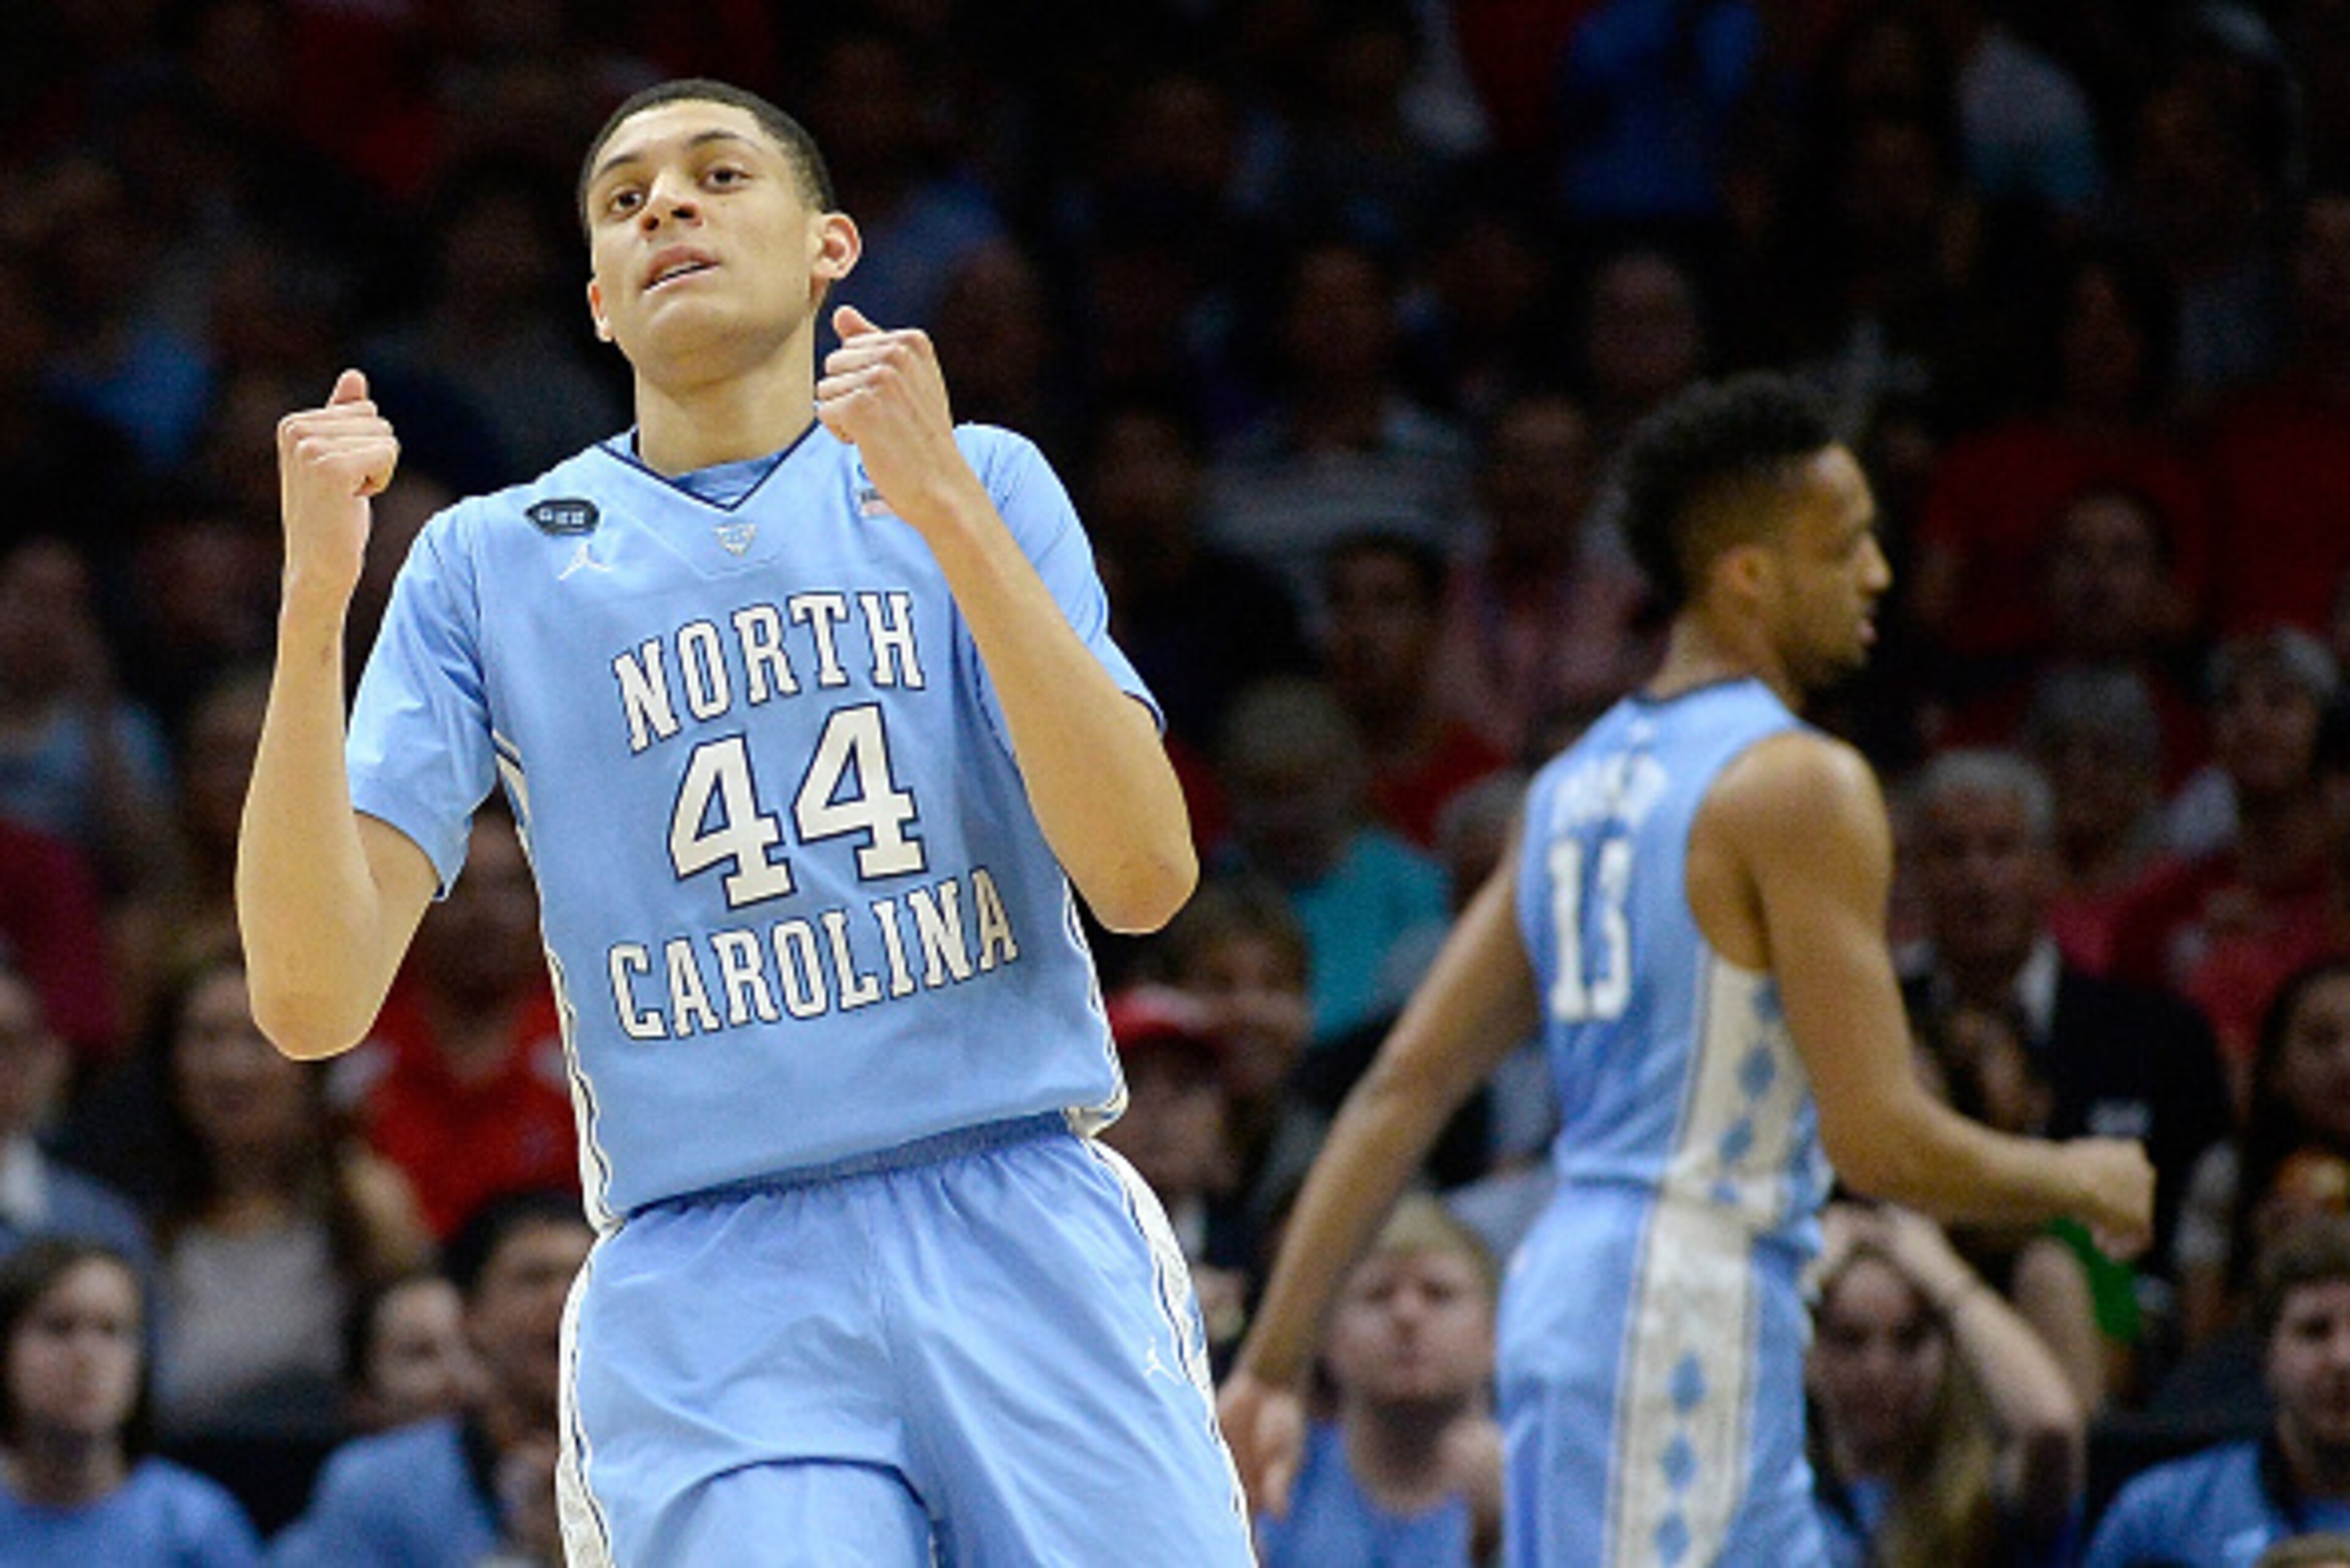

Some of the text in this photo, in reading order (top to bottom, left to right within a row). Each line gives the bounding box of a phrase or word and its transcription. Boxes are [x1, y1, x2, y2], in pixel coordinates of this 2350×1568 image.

[611, 592, 925, 755] NORTH
[667, 701, 928, 909] 44
[608, 866, 1018, 1040] CAROLINA
[1548, 834, 1633, 1023] 13
